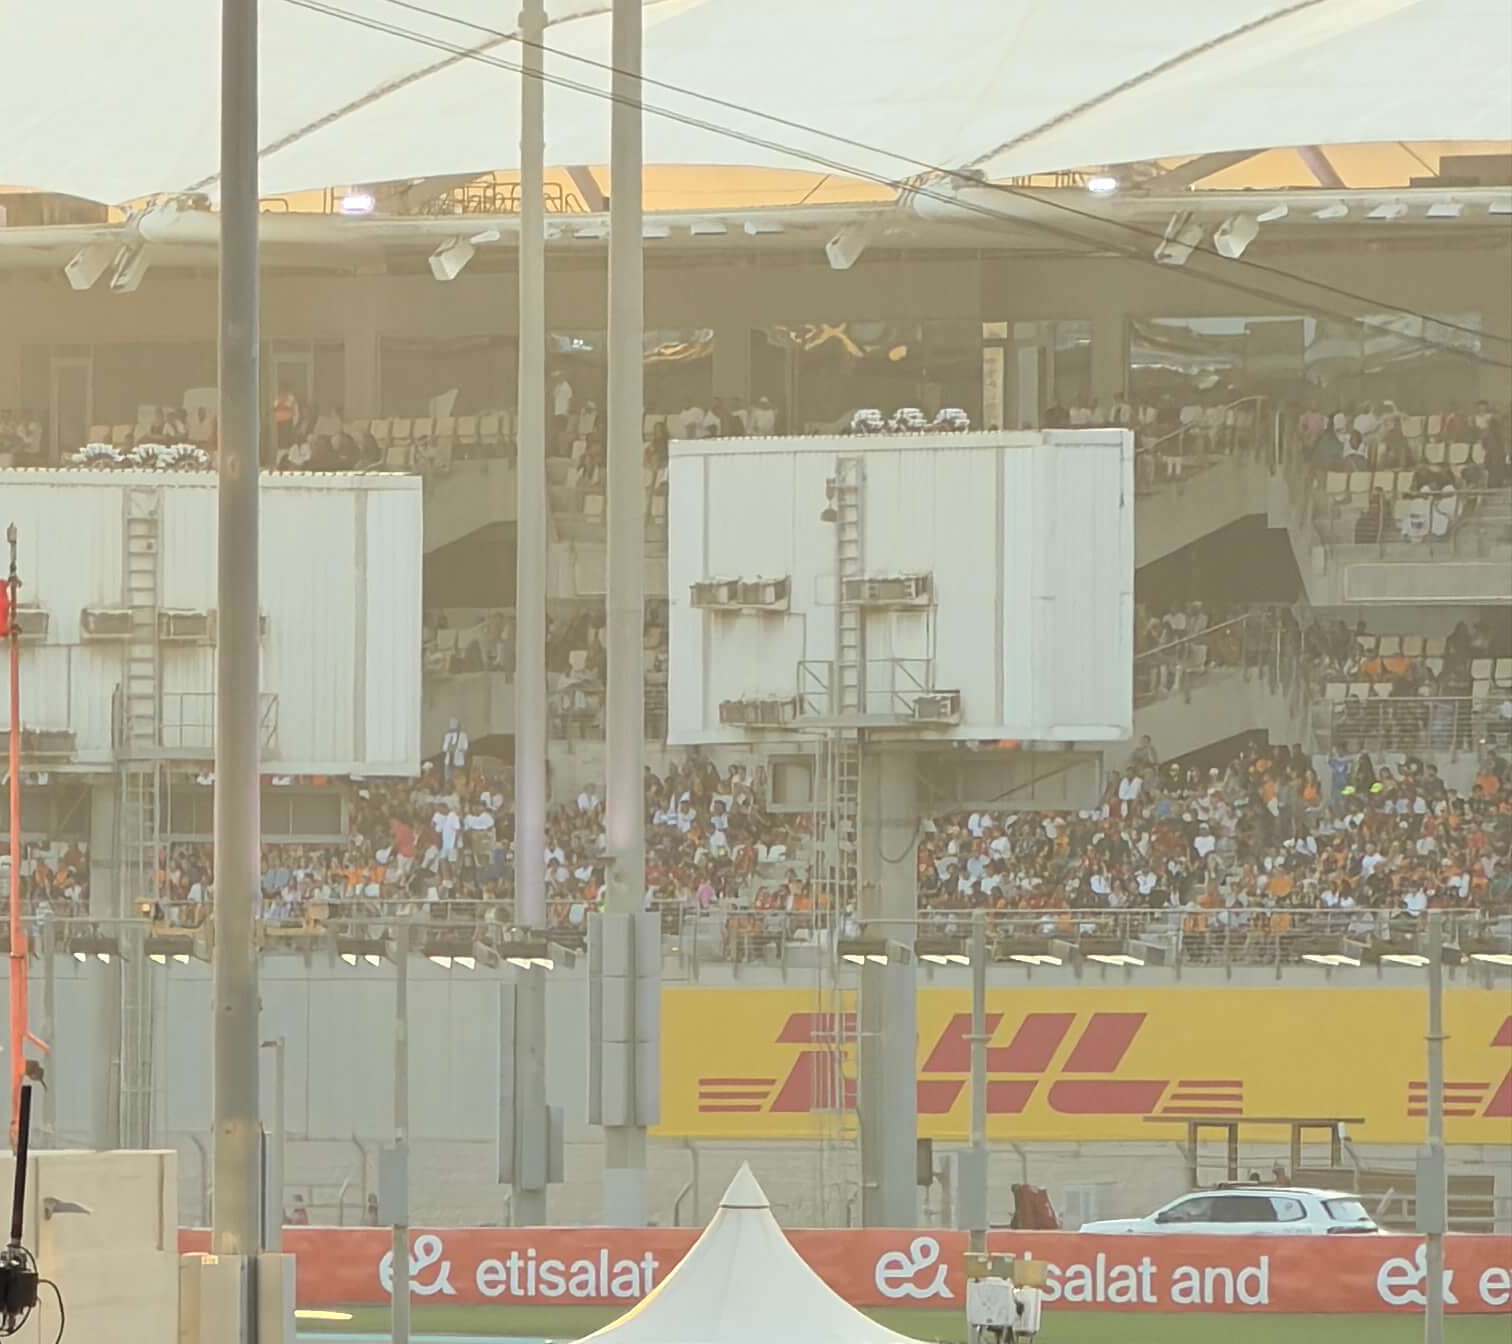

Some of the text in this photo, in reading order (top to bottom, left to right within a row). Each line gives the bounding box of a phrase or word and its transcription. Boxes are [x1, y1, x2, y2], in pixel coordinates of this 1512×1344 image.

[475, 1253, 659, 1299] etisalat
[875, 1236, 1270, 1306] e& salat and
